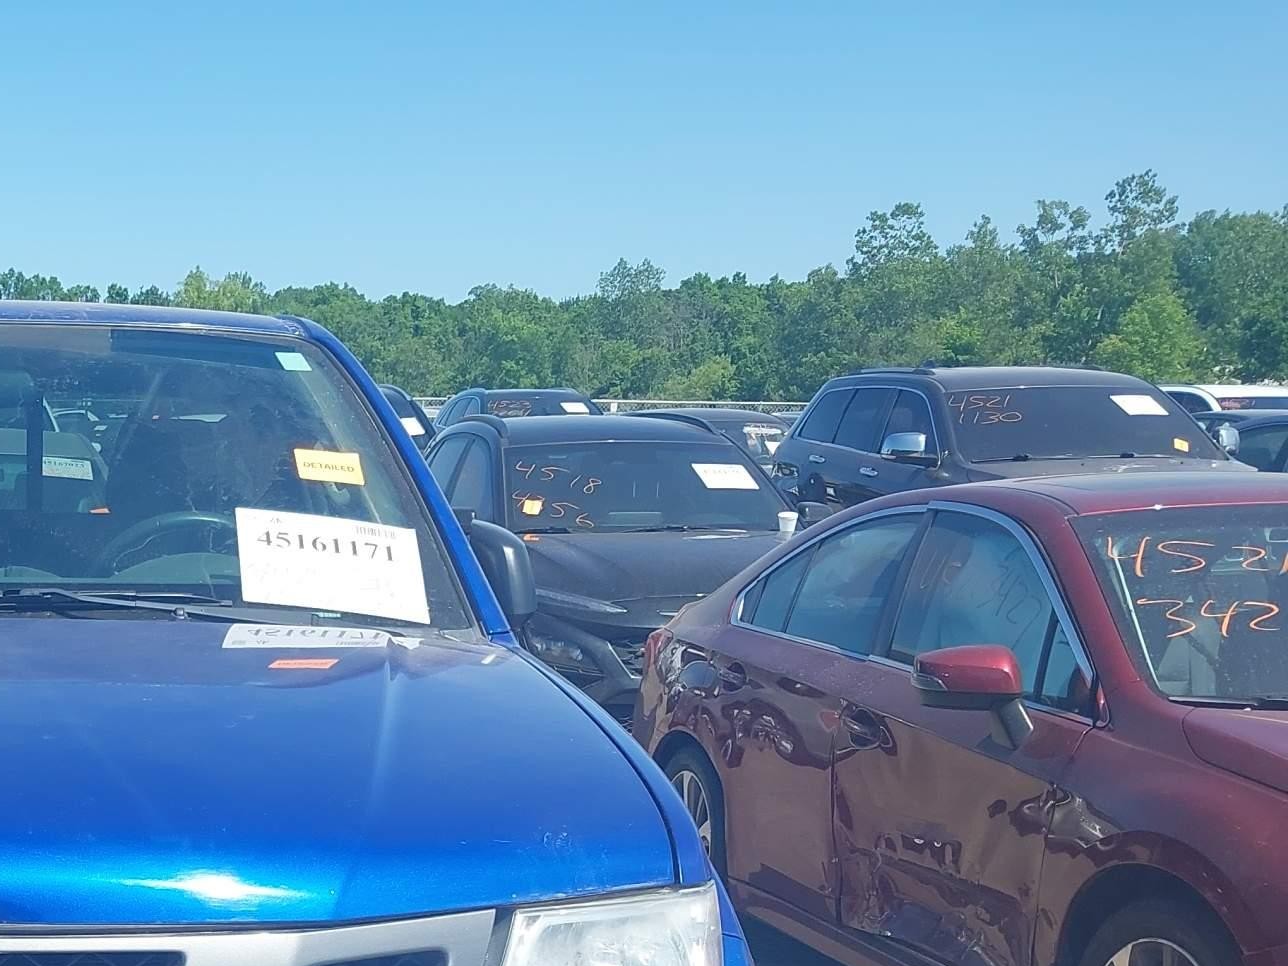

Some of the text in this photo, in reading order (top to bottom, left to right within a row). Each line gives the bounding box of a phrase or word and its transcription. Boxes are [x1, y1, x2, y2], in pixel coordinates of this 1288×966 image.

[948, 395, 1010, 412] 4521
[959, 411, 1022, 425] 1130
[303, 461, 355, 473] DETAILED
[515, 460, 602, 494] 4518
[512, 489, 594, 529] 456
[257, 529, 393, 562] 45161171
[1136, 598, 1281, 638] 342
